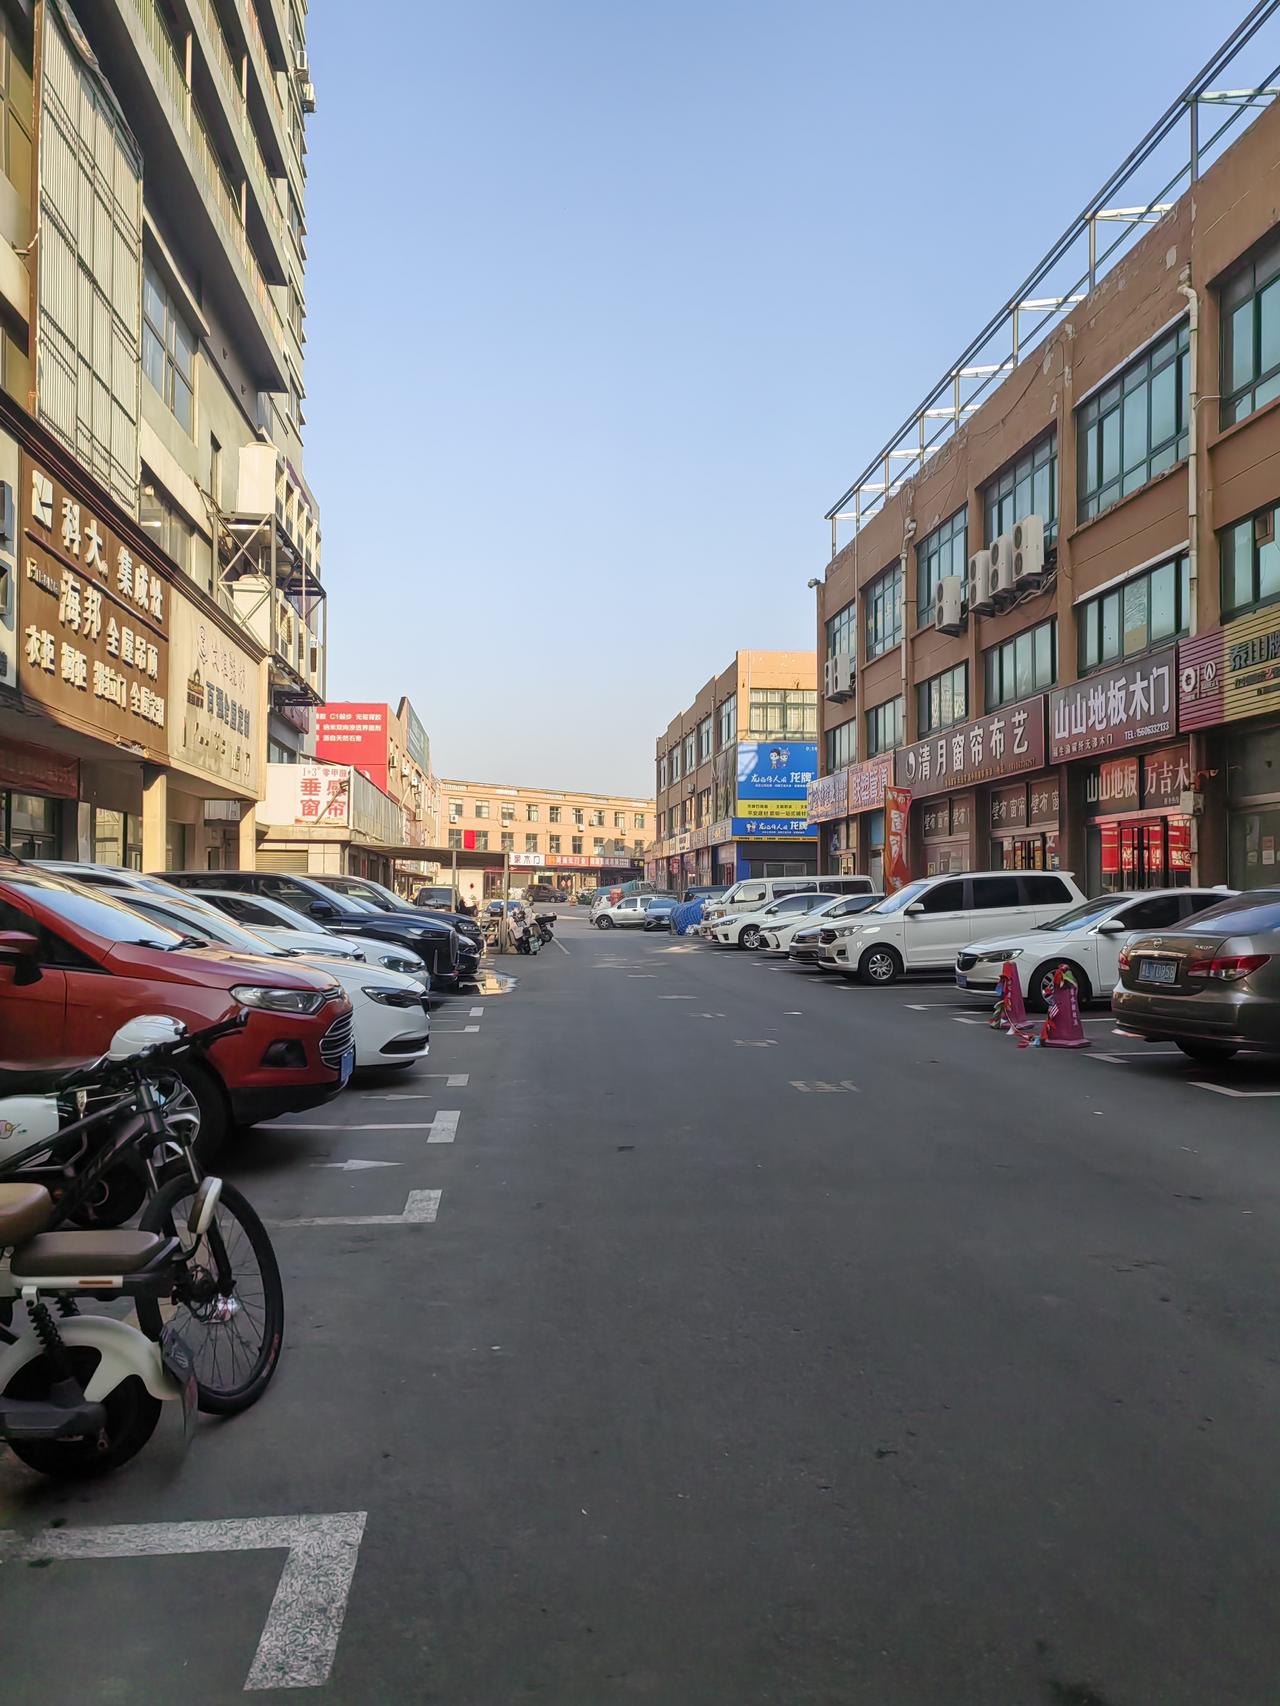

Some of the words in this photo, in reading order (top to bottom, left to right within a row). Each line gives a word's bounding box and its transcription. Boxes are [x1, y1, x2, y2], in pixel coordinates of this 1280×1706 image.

[62, 497, 104, 576] 科大
[117, 546, 162, 623] 集成灶
[59, 569, 101, 640] 海邦
[106, 617, 158, 679] 全屋吊顶
[25, 625, 55, 673] 衣柜
[61, 642, 87, 690] 橱柜
[130, 681, 164, 727] 全屋定制
[1055, 665, 1169, 740] 山山地板木门
[790, 771, 812, 783] 龙牌
[918, 710, 1029, 781] 清月窗帘布艺
[300, 799, 347, 817] 窗帘
[1010, 797, 1025, 818] 窗帘
[1086, 764, 1138, 803] 山山地板
